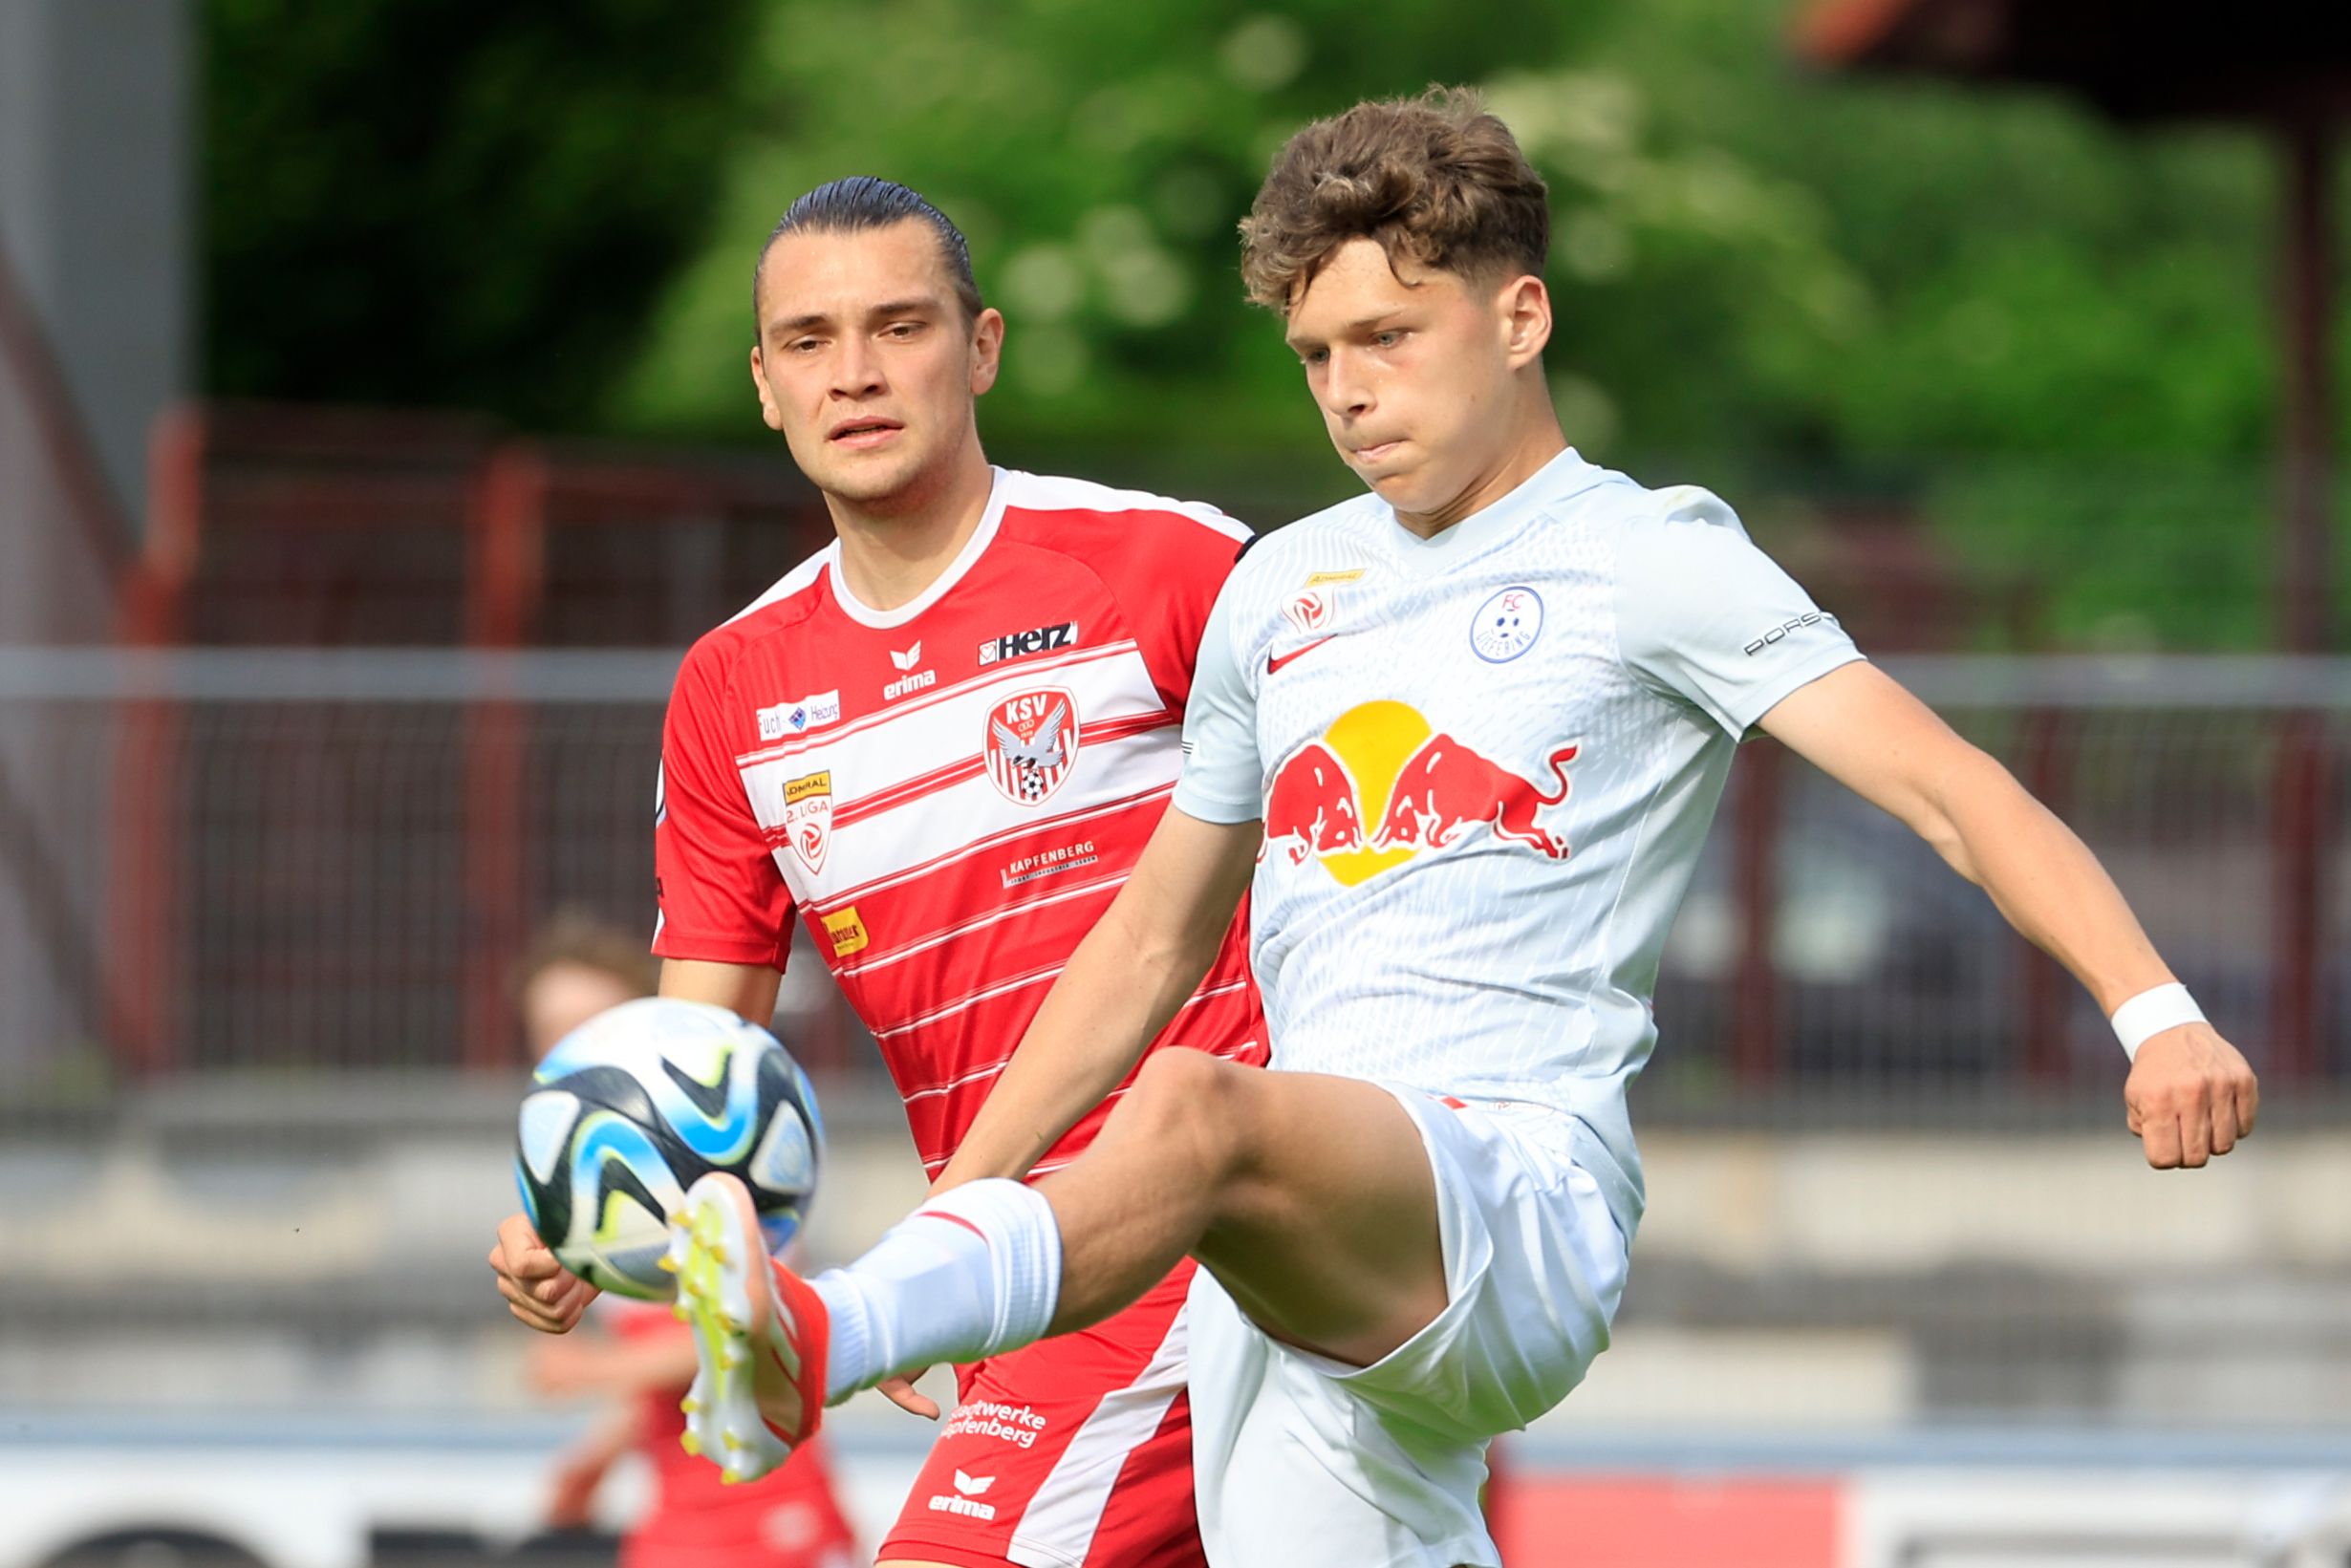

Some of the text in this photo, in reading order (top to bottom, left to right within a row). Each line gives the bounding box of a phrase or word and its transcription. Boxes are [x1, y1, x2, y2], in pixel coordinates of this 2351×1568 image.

[1501, 593, 1525, 610] FC
[999, 622, 1071, 660] Herz
[883, 669, 938, 700] erima
[1006, 694, 1047, 724] KSV
[1009, 840, 1095, 874] KAPFENBERG
[927, 1494, 996, 1521] erima
